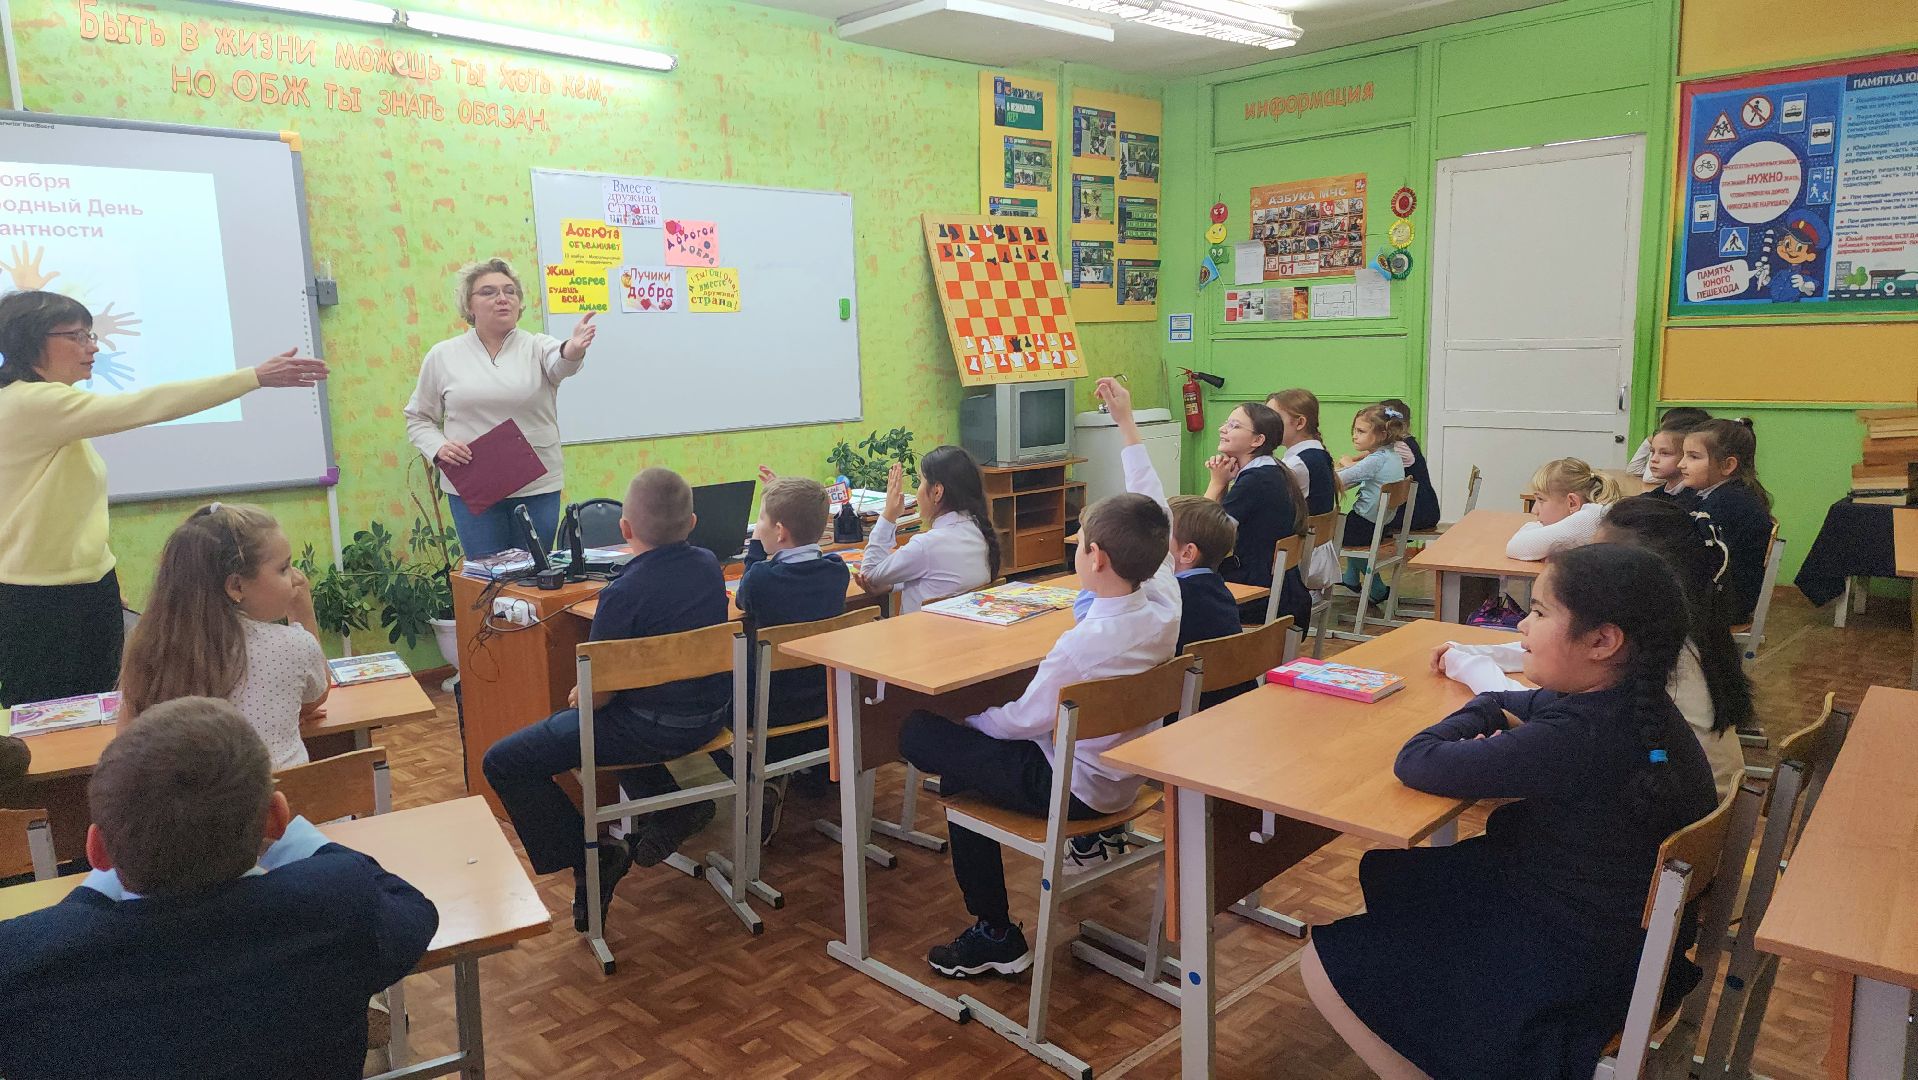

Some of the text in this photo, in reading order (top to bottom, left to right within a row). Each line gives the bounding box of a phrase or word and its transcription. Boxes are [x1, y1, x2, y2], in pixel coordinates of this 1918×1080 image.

[451, 59, 486, 88] ты
[1853, 71, 1918, 89] ПАМЯТКА Ю
[171, 65, 216, 98] НО
[232, 69, 310, 107] ОБЖ
[324, 82, 362, 112] ТЫ
[377, 89, 445, 122] ЗНАТЬ
[0, 172, 71, 192] оября
[1746, 171, 1783, 184] НУЖНО
[613, 179, 652, 195] Вместе
[1268, 187, 1347, 206] АЗБУКА МЧС
[0, 198, 144, 218] одный День
[0, 223, 105, 238] антности
[1280, 264, 1295, 275] 01
[1697, 265, 1734, 280] ПАМЯТКА
[1703, 275, 1731, 288] ЮНОГО
[627, 282, 674, 303] добра
[1696, 283, 1740, 299] ПЕШЕХОДА
